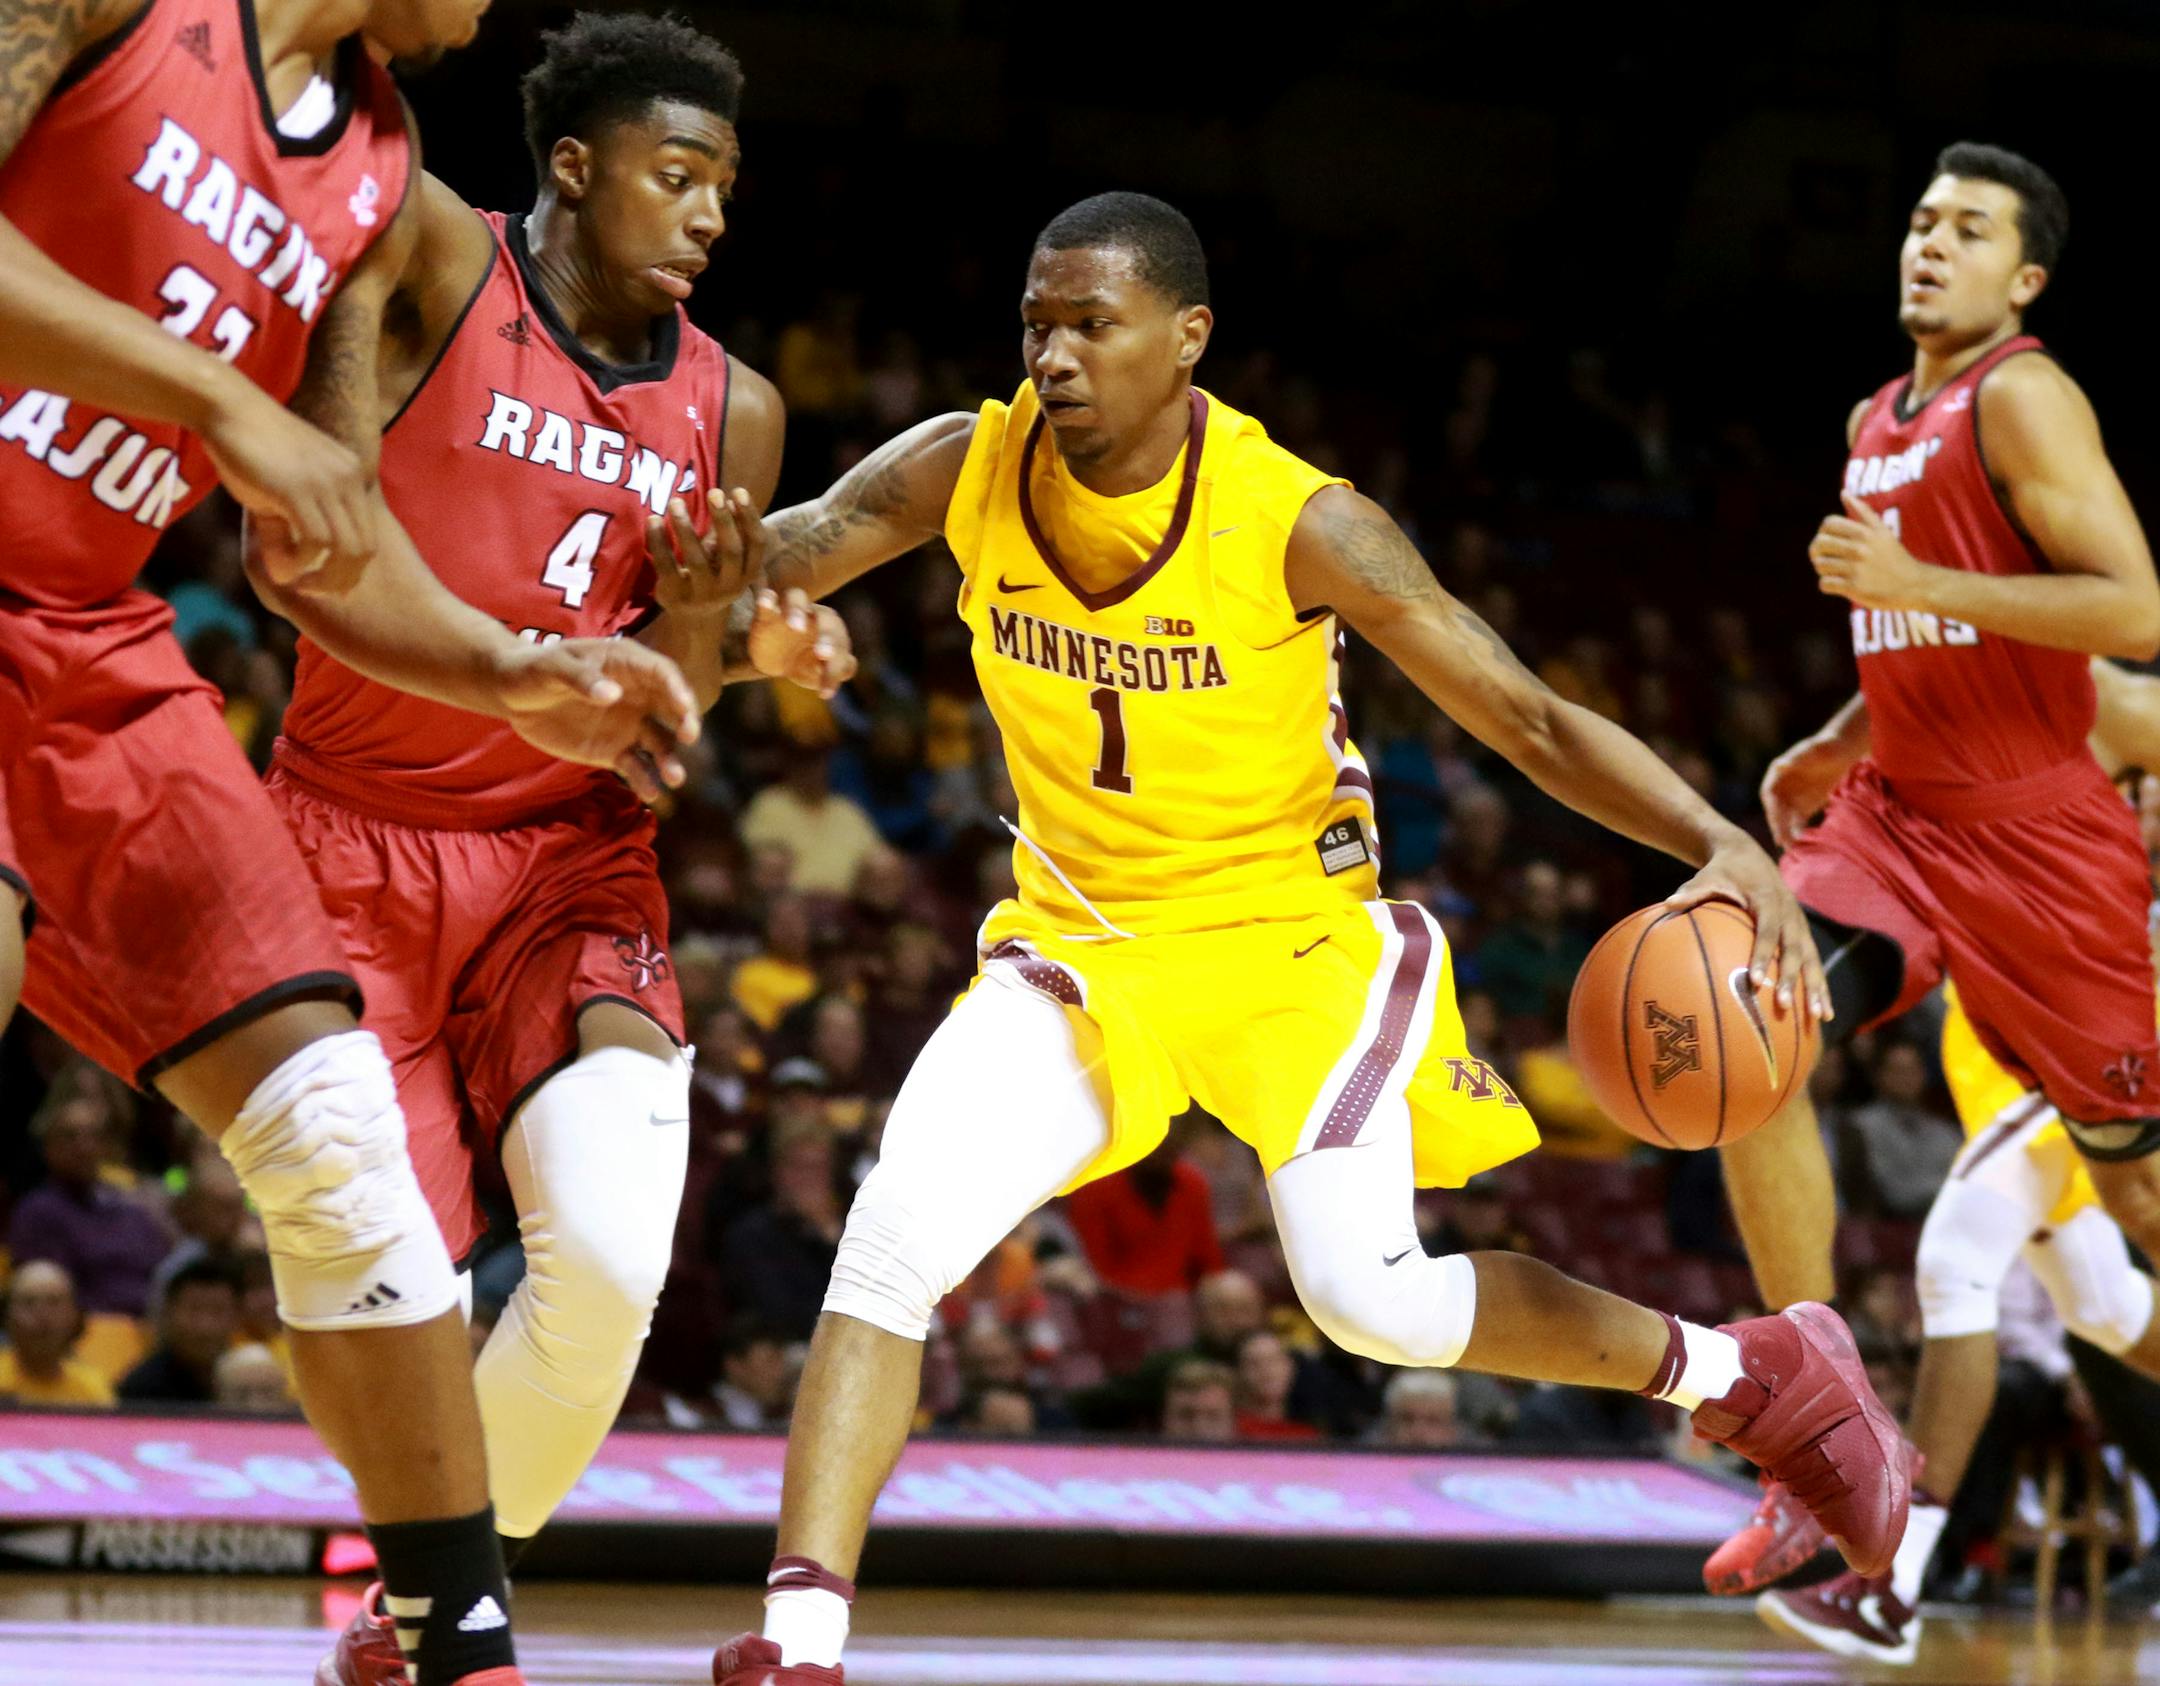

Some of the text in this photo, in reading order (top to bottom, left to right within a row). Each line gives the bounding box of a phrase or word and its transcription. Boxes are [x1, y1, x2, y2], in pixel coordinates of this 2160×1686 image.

[540, 508, 614, 610] 4
[989, 605, 1228, 692] MINNESOTA
[1089, 686, 1132, 794] 1
[1324, 826, 1350, 846] 46
